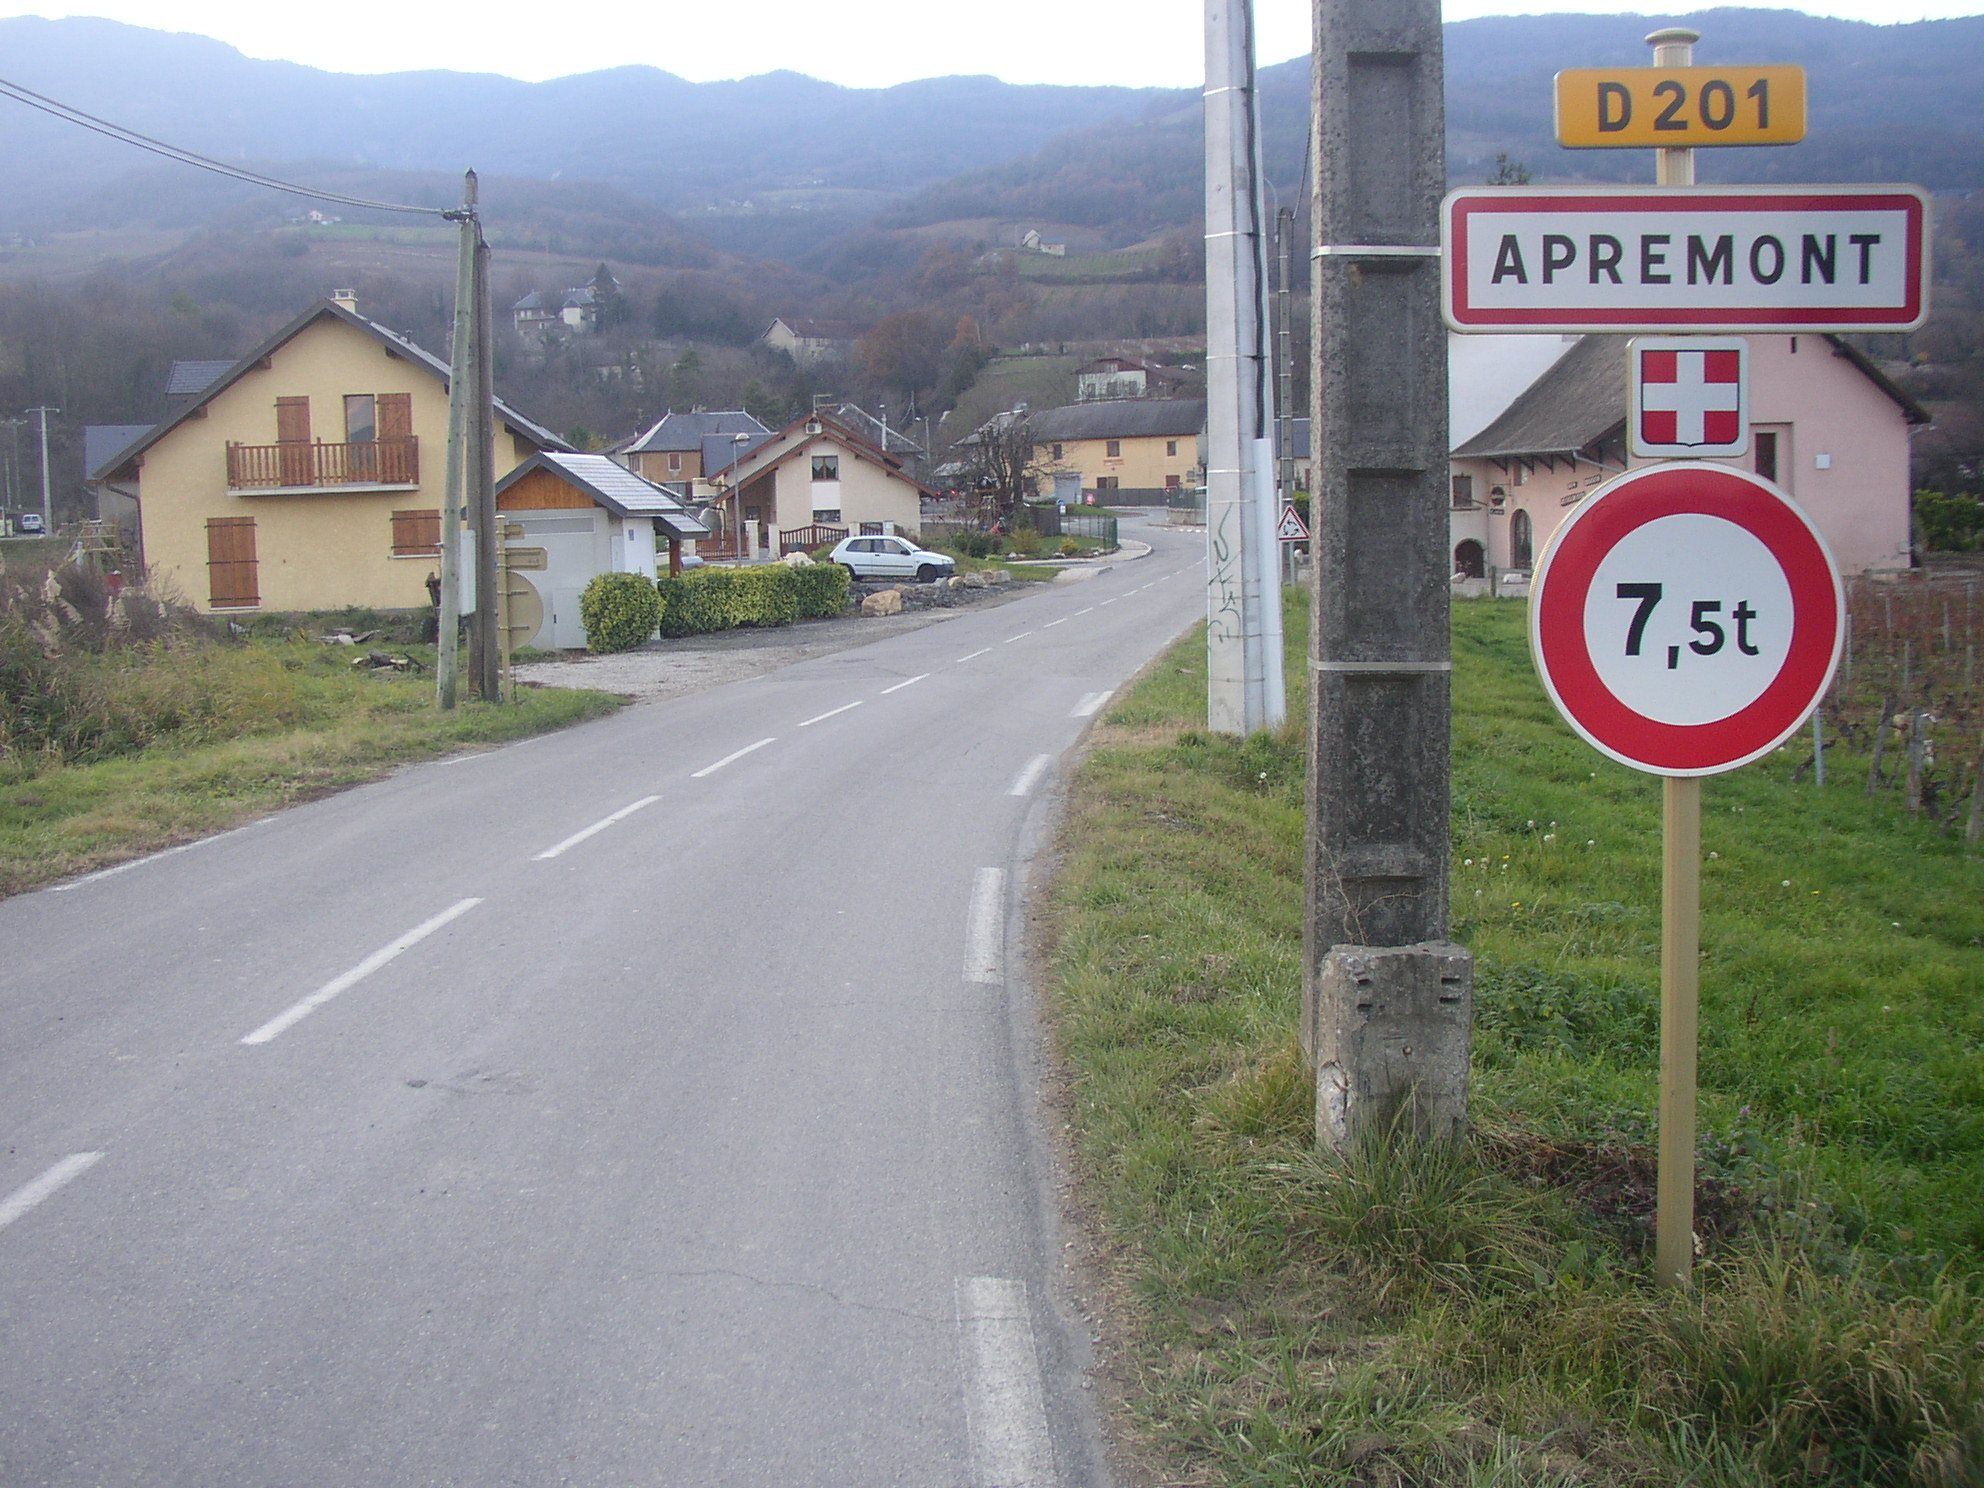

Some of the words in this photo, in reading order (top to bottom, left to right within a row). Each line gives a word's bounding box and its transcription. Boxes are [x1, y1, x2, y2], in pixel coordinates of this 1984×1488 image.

[1597, 81, 1632, 132] D
[1653, 78, 1770, 131] 201
[1490, 233, 1881, 286] APREMONT
[1615, 582, 1760, 670] 7,5t
